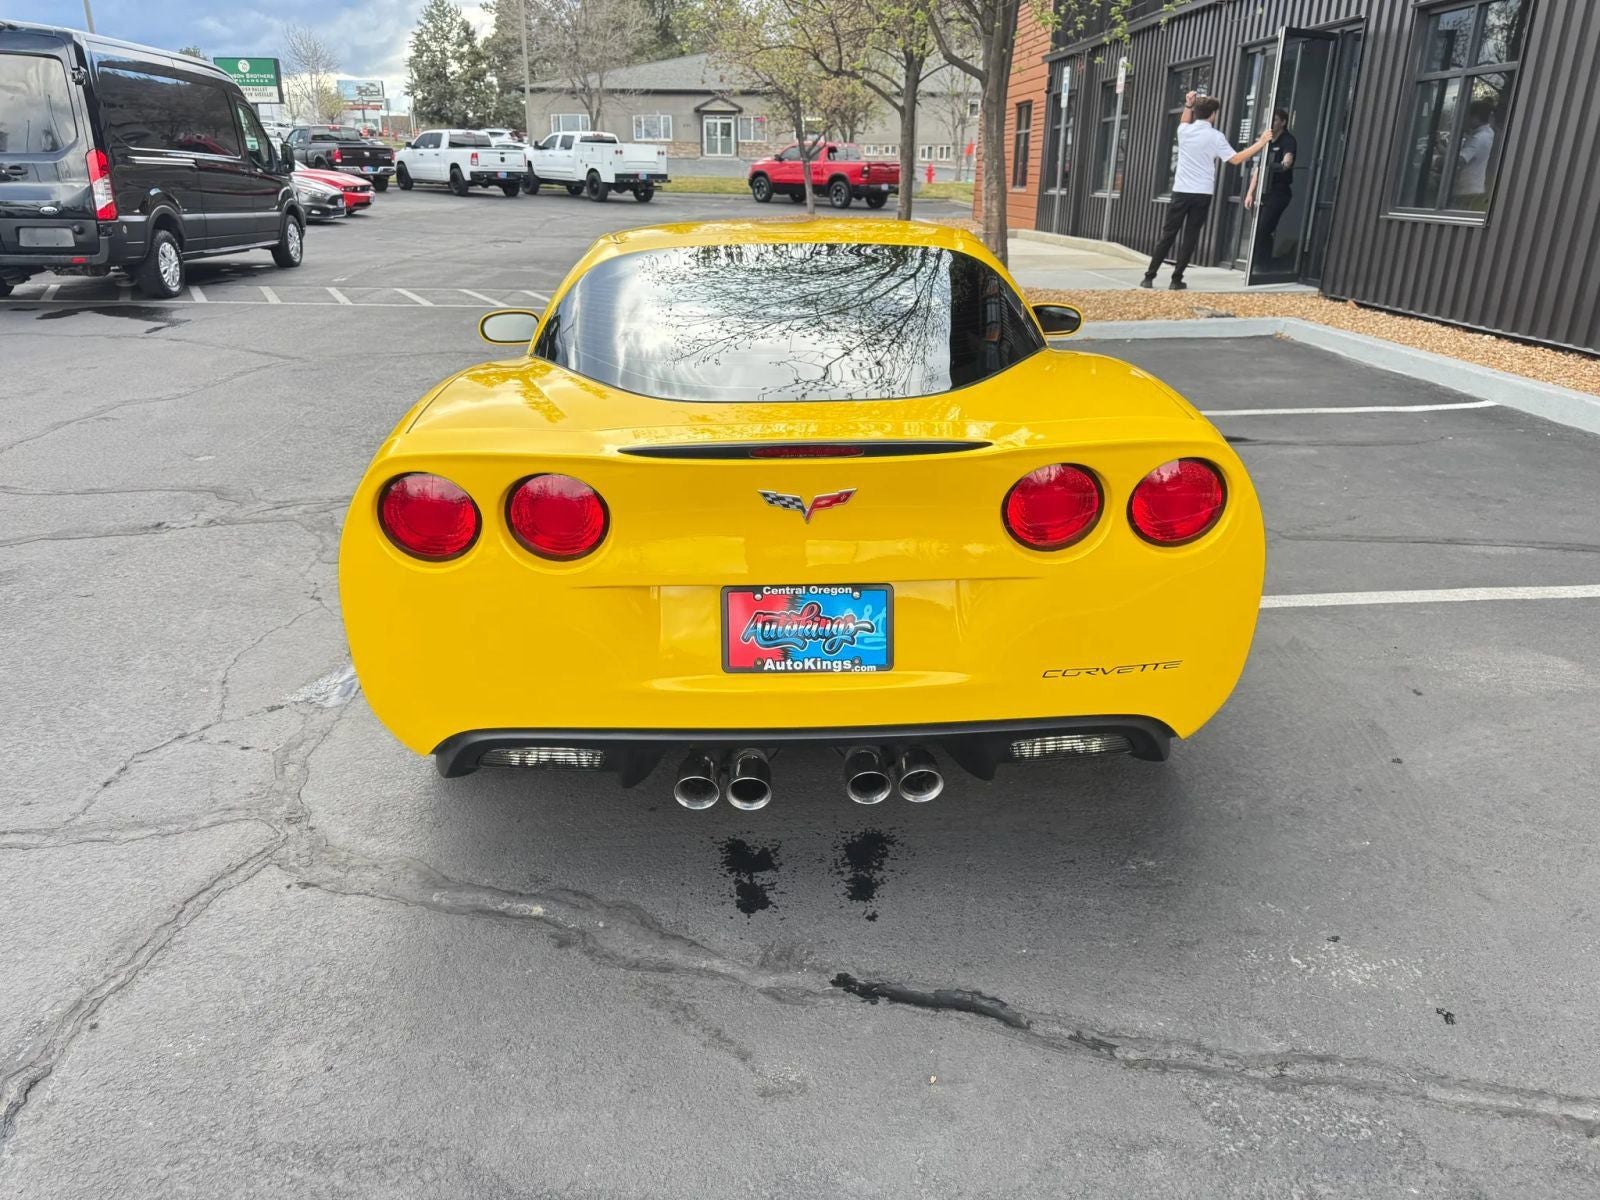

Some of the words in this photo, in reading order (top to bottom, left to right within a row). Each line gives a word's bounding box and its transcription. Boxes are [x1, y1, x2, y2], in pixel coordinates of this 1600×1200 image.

[762, 586, 806, 595] Central
[809, 586, 853, 596] Oregon
[1042, 660, 1183, 679] CORVETTE
